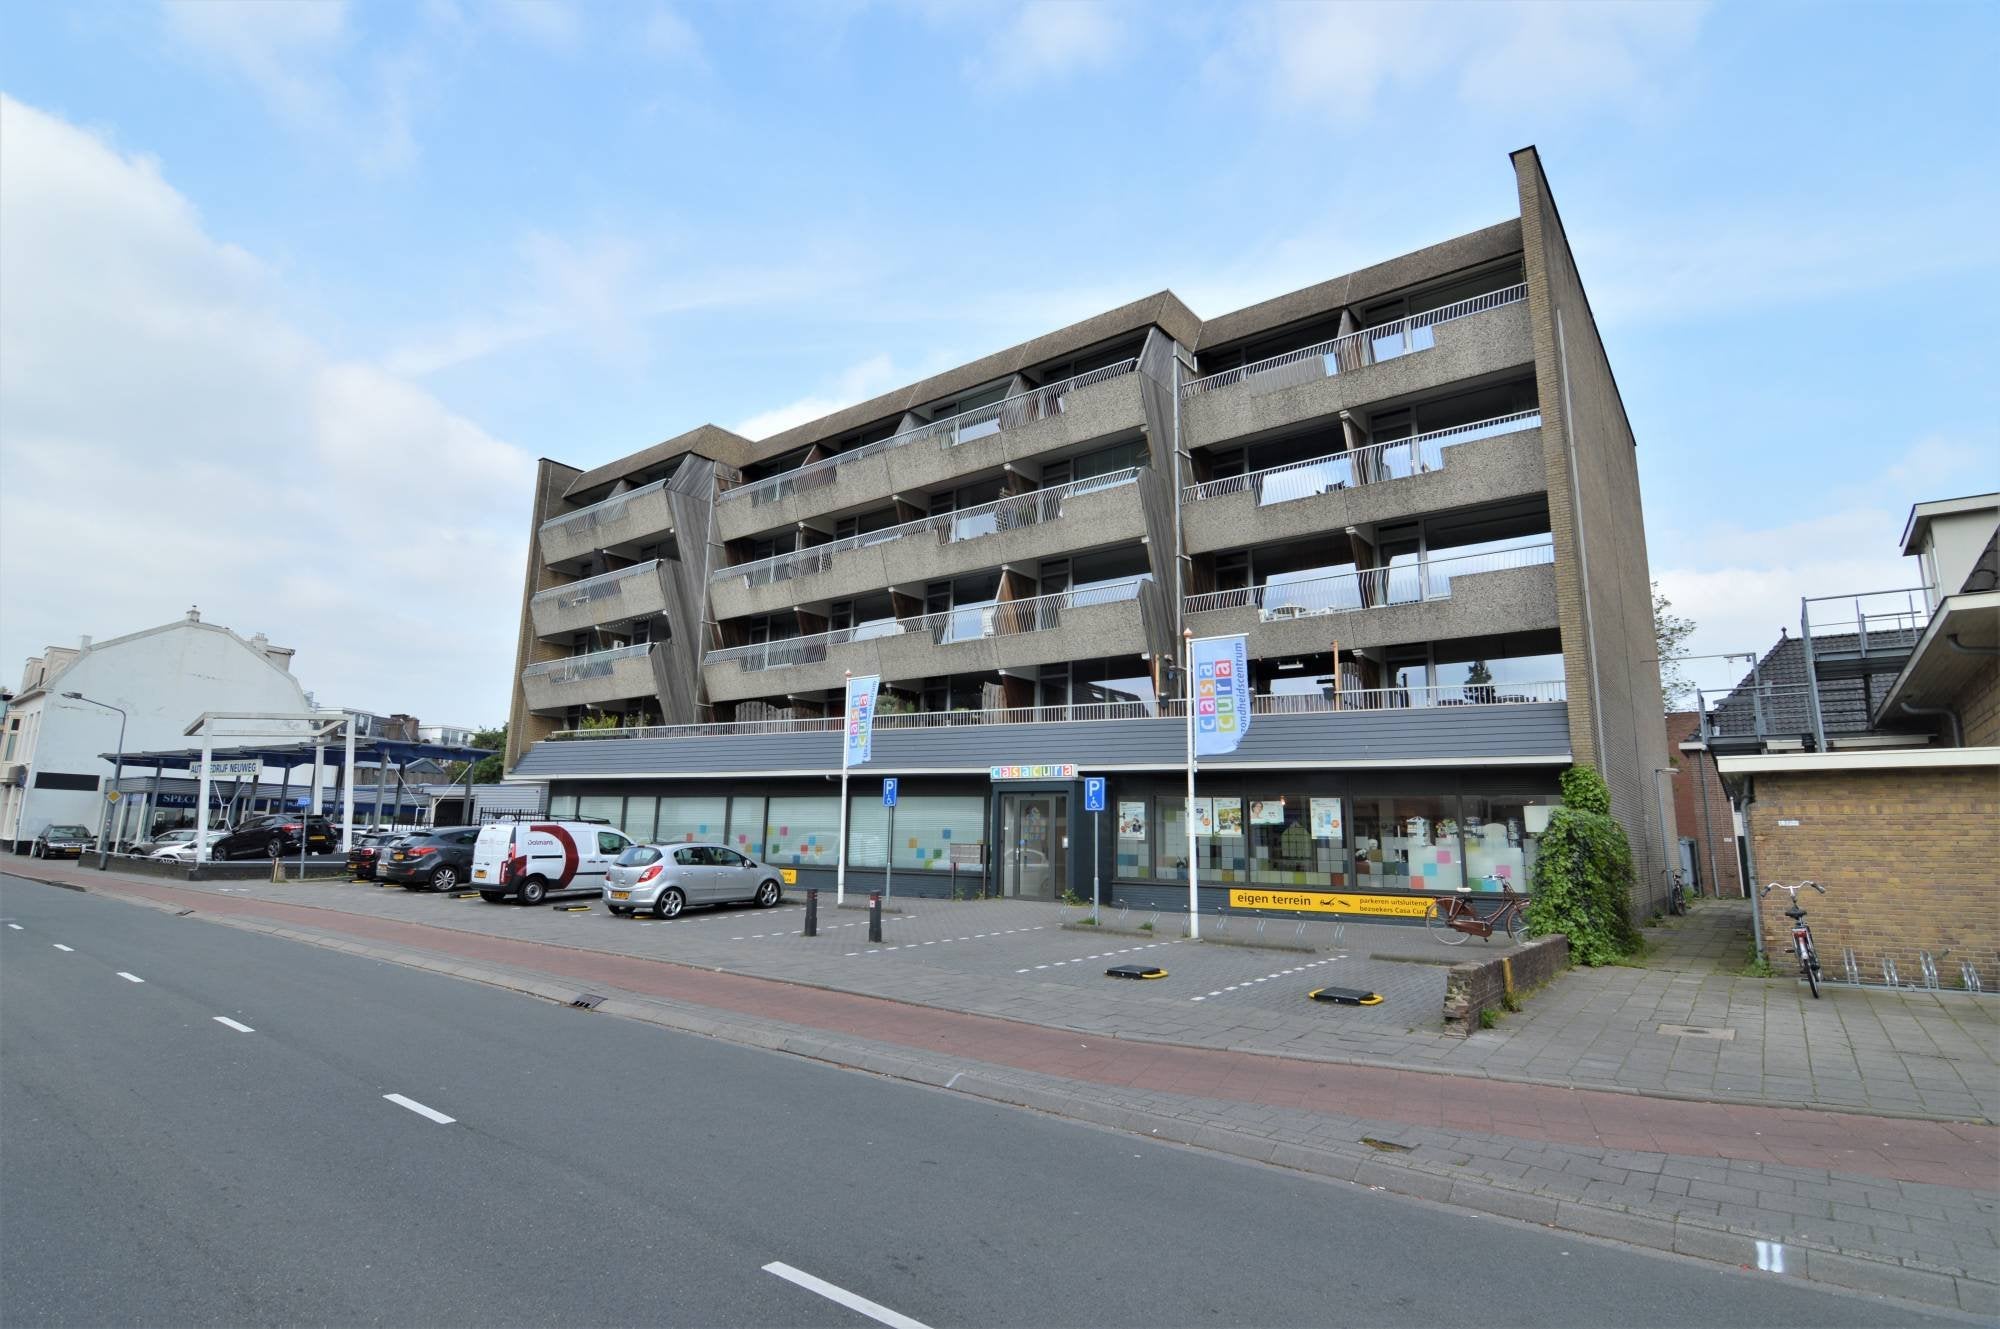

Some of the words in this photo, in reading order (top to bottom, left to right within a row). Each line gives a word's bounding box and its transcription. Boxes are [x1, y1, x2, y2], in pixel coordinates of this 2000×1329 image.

[1199, 662, 1216, 733] casa
[1215, 660, 1236, 732] cura
[1234, 642, 1248, 746] zondheidscentrum
[850, 695, 859, 749] casa
[859, 694, 868, 748] cura
[229, 762, 257, 773] NEUWEG
[992, 764, 1074, 779] casacura
[886, 780, 894, 795] P
[1089, 780, 1100, 797] P
[1237, 892, 1269, 906] eigen
[1272, 894, 1312, 906] terrein
[1391, 899, 1428, 907] uitsluitend
